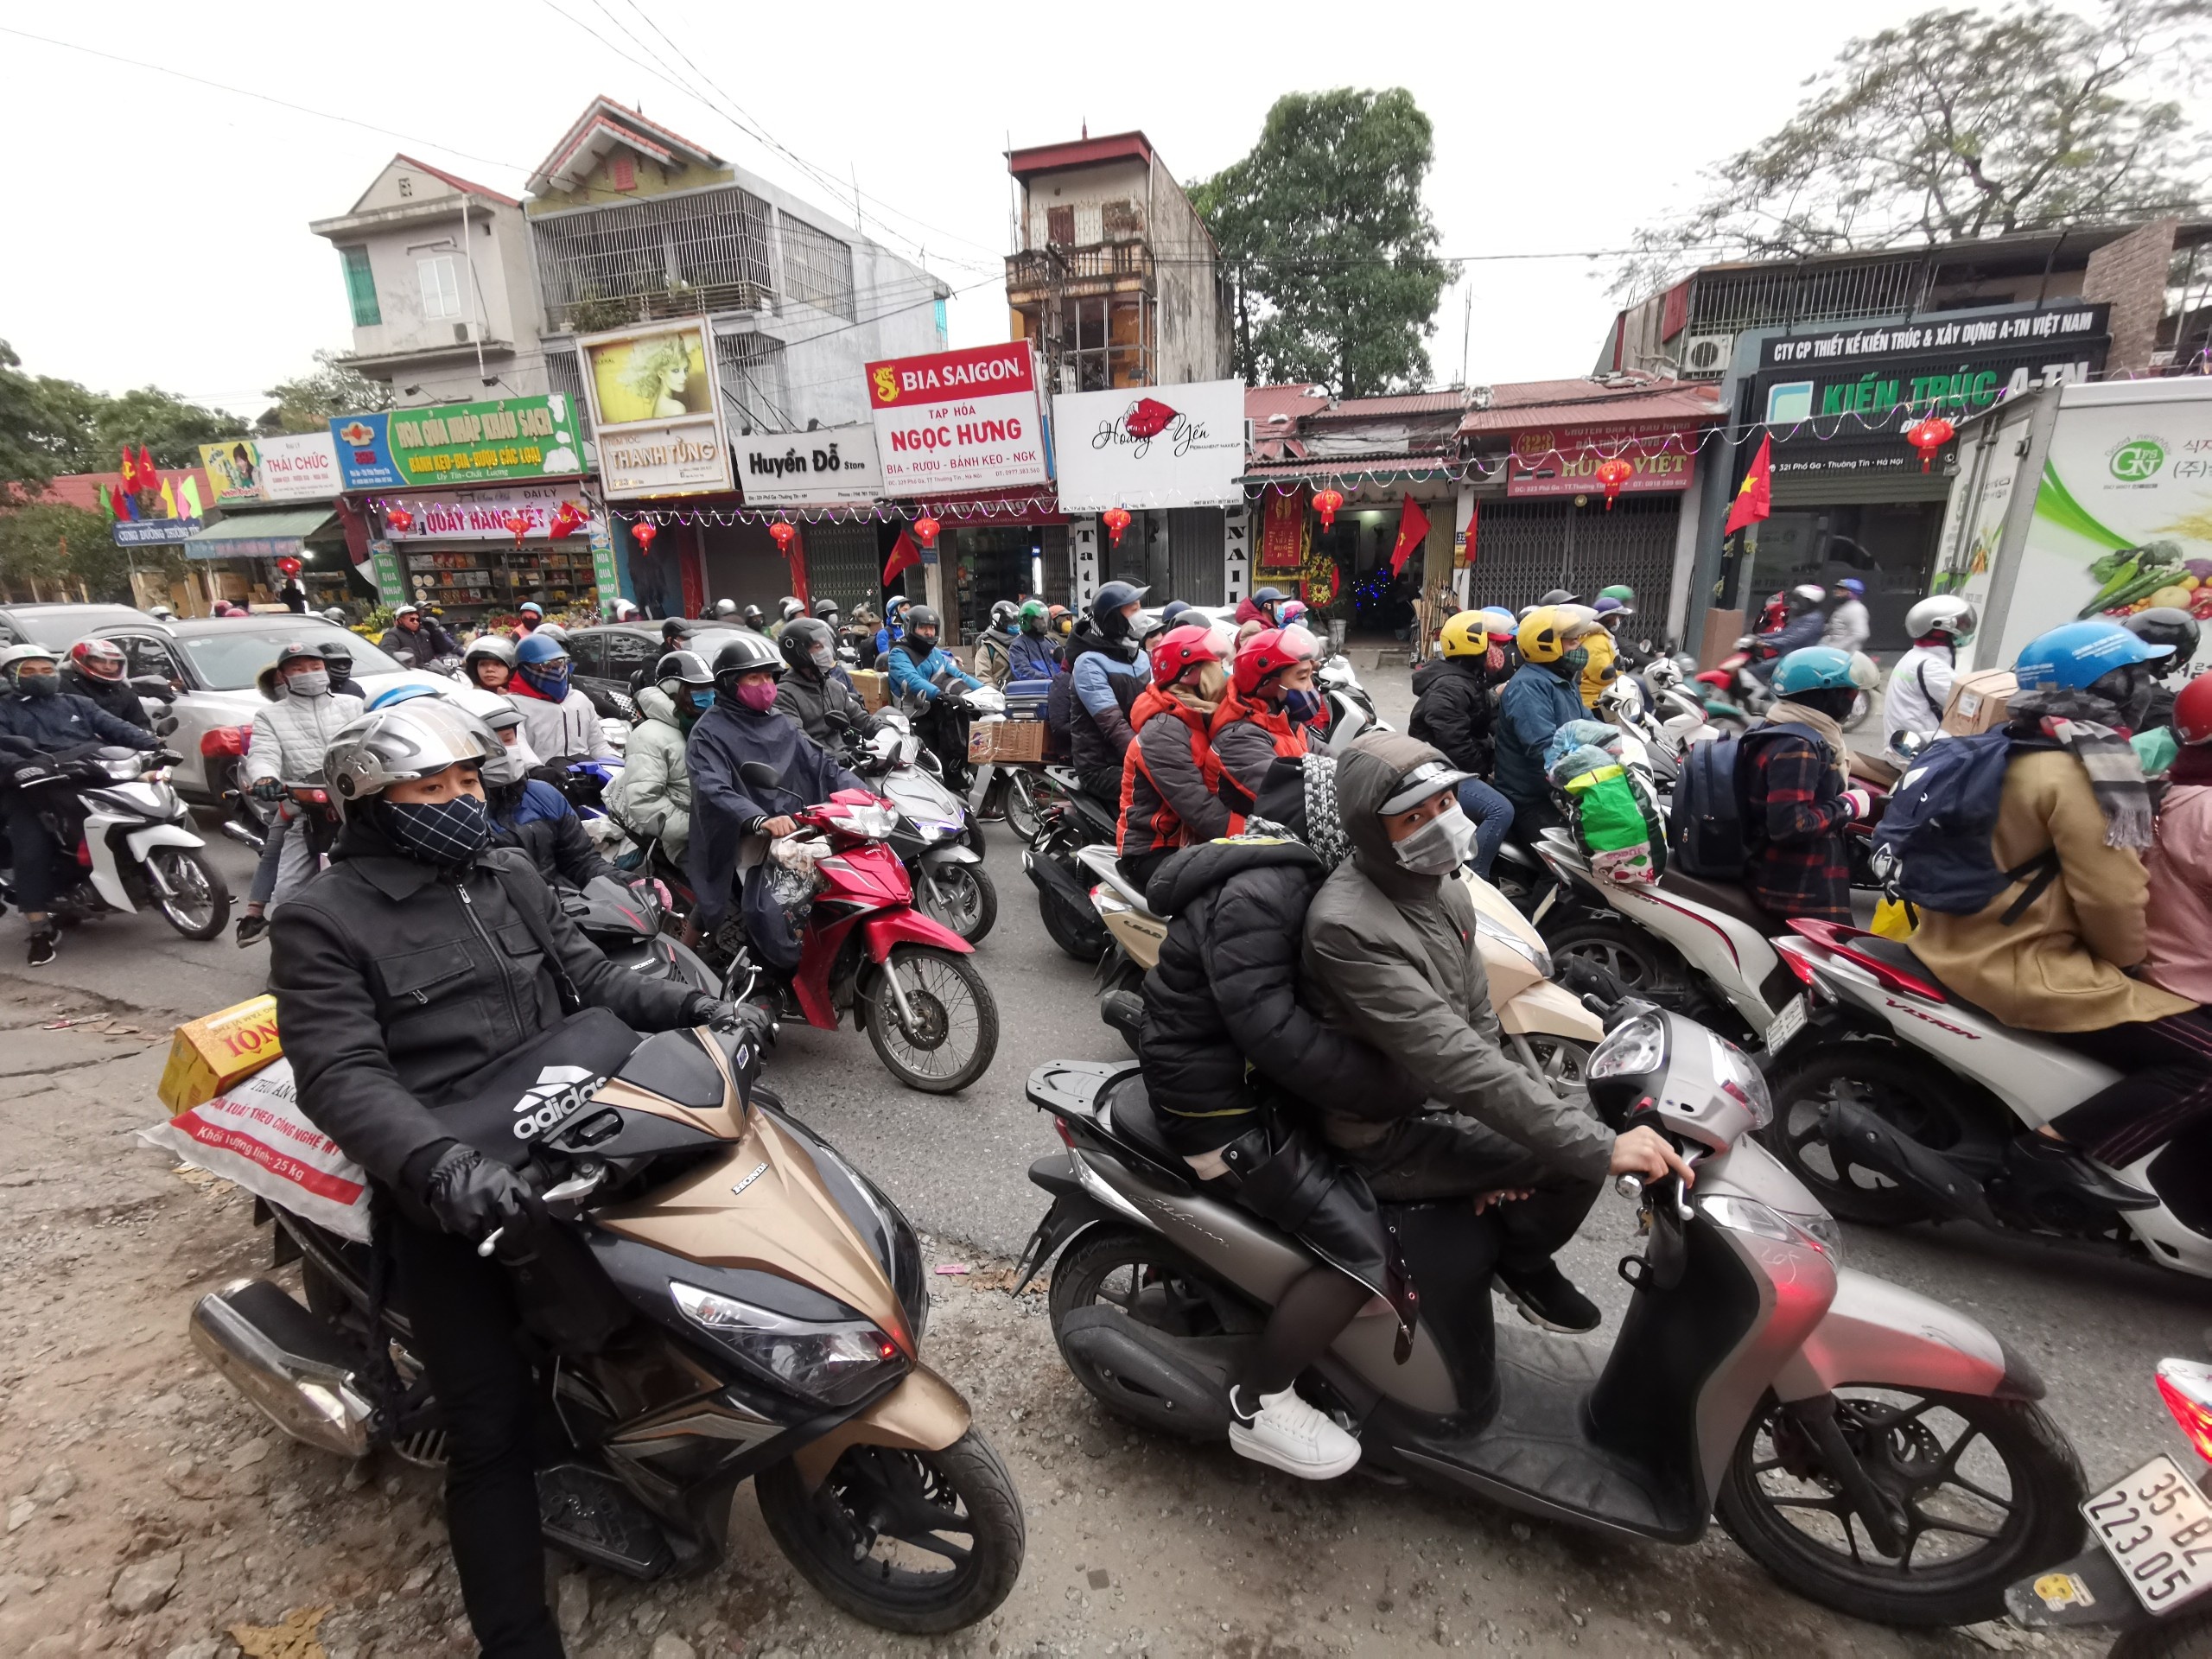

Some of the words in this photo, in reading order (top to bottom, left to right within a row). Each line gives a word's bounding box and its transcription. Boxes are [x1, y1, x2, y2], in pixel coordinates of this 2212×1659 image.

[1774, 342, 1795, 361] CTY
[1796, 340, 1811, 359] CP
[1814, 333, 1844, 358] THIẾT
[1845, 330, 1863, 354] KẾ
[1860, 328, 1890, 353] KIẾN
[1891, 327, 1922, 350] TRÚC
[1923, 329, 1932, 347] &
[1935, 322, 1961, 346] XÂY
[1961, 321, 1997, 346] DỰNG
[1999, 318, 2031, 339] A-TN
[2032, 312, 2061, 338] VIỆT
[2061, 312, 2093, 333] NAM
[902, 370, 940, 391] BIA
[943, 357, 1020, 386] SAIGON
[1821, 372, 1900, 416] KIẾN
[1910, 365, 1997, 410] TRÚC
[929, 408, 949, 421] TẠP
[954, 403, 976, 417] HÓA
[395, 420, 424, 448] HOA
[891, 426, 951, 454] NGỌC
[956, 417, 1022, 446] HƯNG
[1164, 413, 1210, 458] Yến
[1521, 434, 1554, 454] 323
[266, 454, 292, 472] THÁI
[295, 451, 328, 470] CHỨC
[609, 445, 667, 470] THANH
[668, 435, 716, 465] TÙNG
[749, 447, 807, 478] Huyền
[812, 442, 841, 472] Đỗ
[844, 461, 865, 470] Store
[887, 462, 904, 474] BIA
[950, 454, 980, 468] BÁNH
[982, 454, 1003, 467] KẸO
[1014, 451, 1037, 463] NGK
[1634, 451, 1688, 477] VIỆT
[1778, 463, 1791, 472] 321
[1792, 461, 1808, 471] Phố
[1827, 460, 1857, 469] Thường
[1890, 458, 1904, 467] Nội
[596, 553, 609, 563] HOA
[1123, 920, 1163, 939] LEAD
[1885, 997, 1982, 1040] VISION
[513, 1077, 607, 1140] adidas
[250, 1108, 275, 1125] THEO
[272, 1117, 296, 1136] CÔNG
[291, 1128, 324, 1151] NGHỆ
[197, 1126, 223, 1143] Khối
[225, 1135, 253, 1158] lượng
[253, 1146, 273, 1166] tịnh:
[273, 1158, 289, 1172] 25
[289, 1164, 305, 1182] kg
[732, 1161, 770, 1195] HONDA
[2088, 1490, 2192, 1601] 223.05
